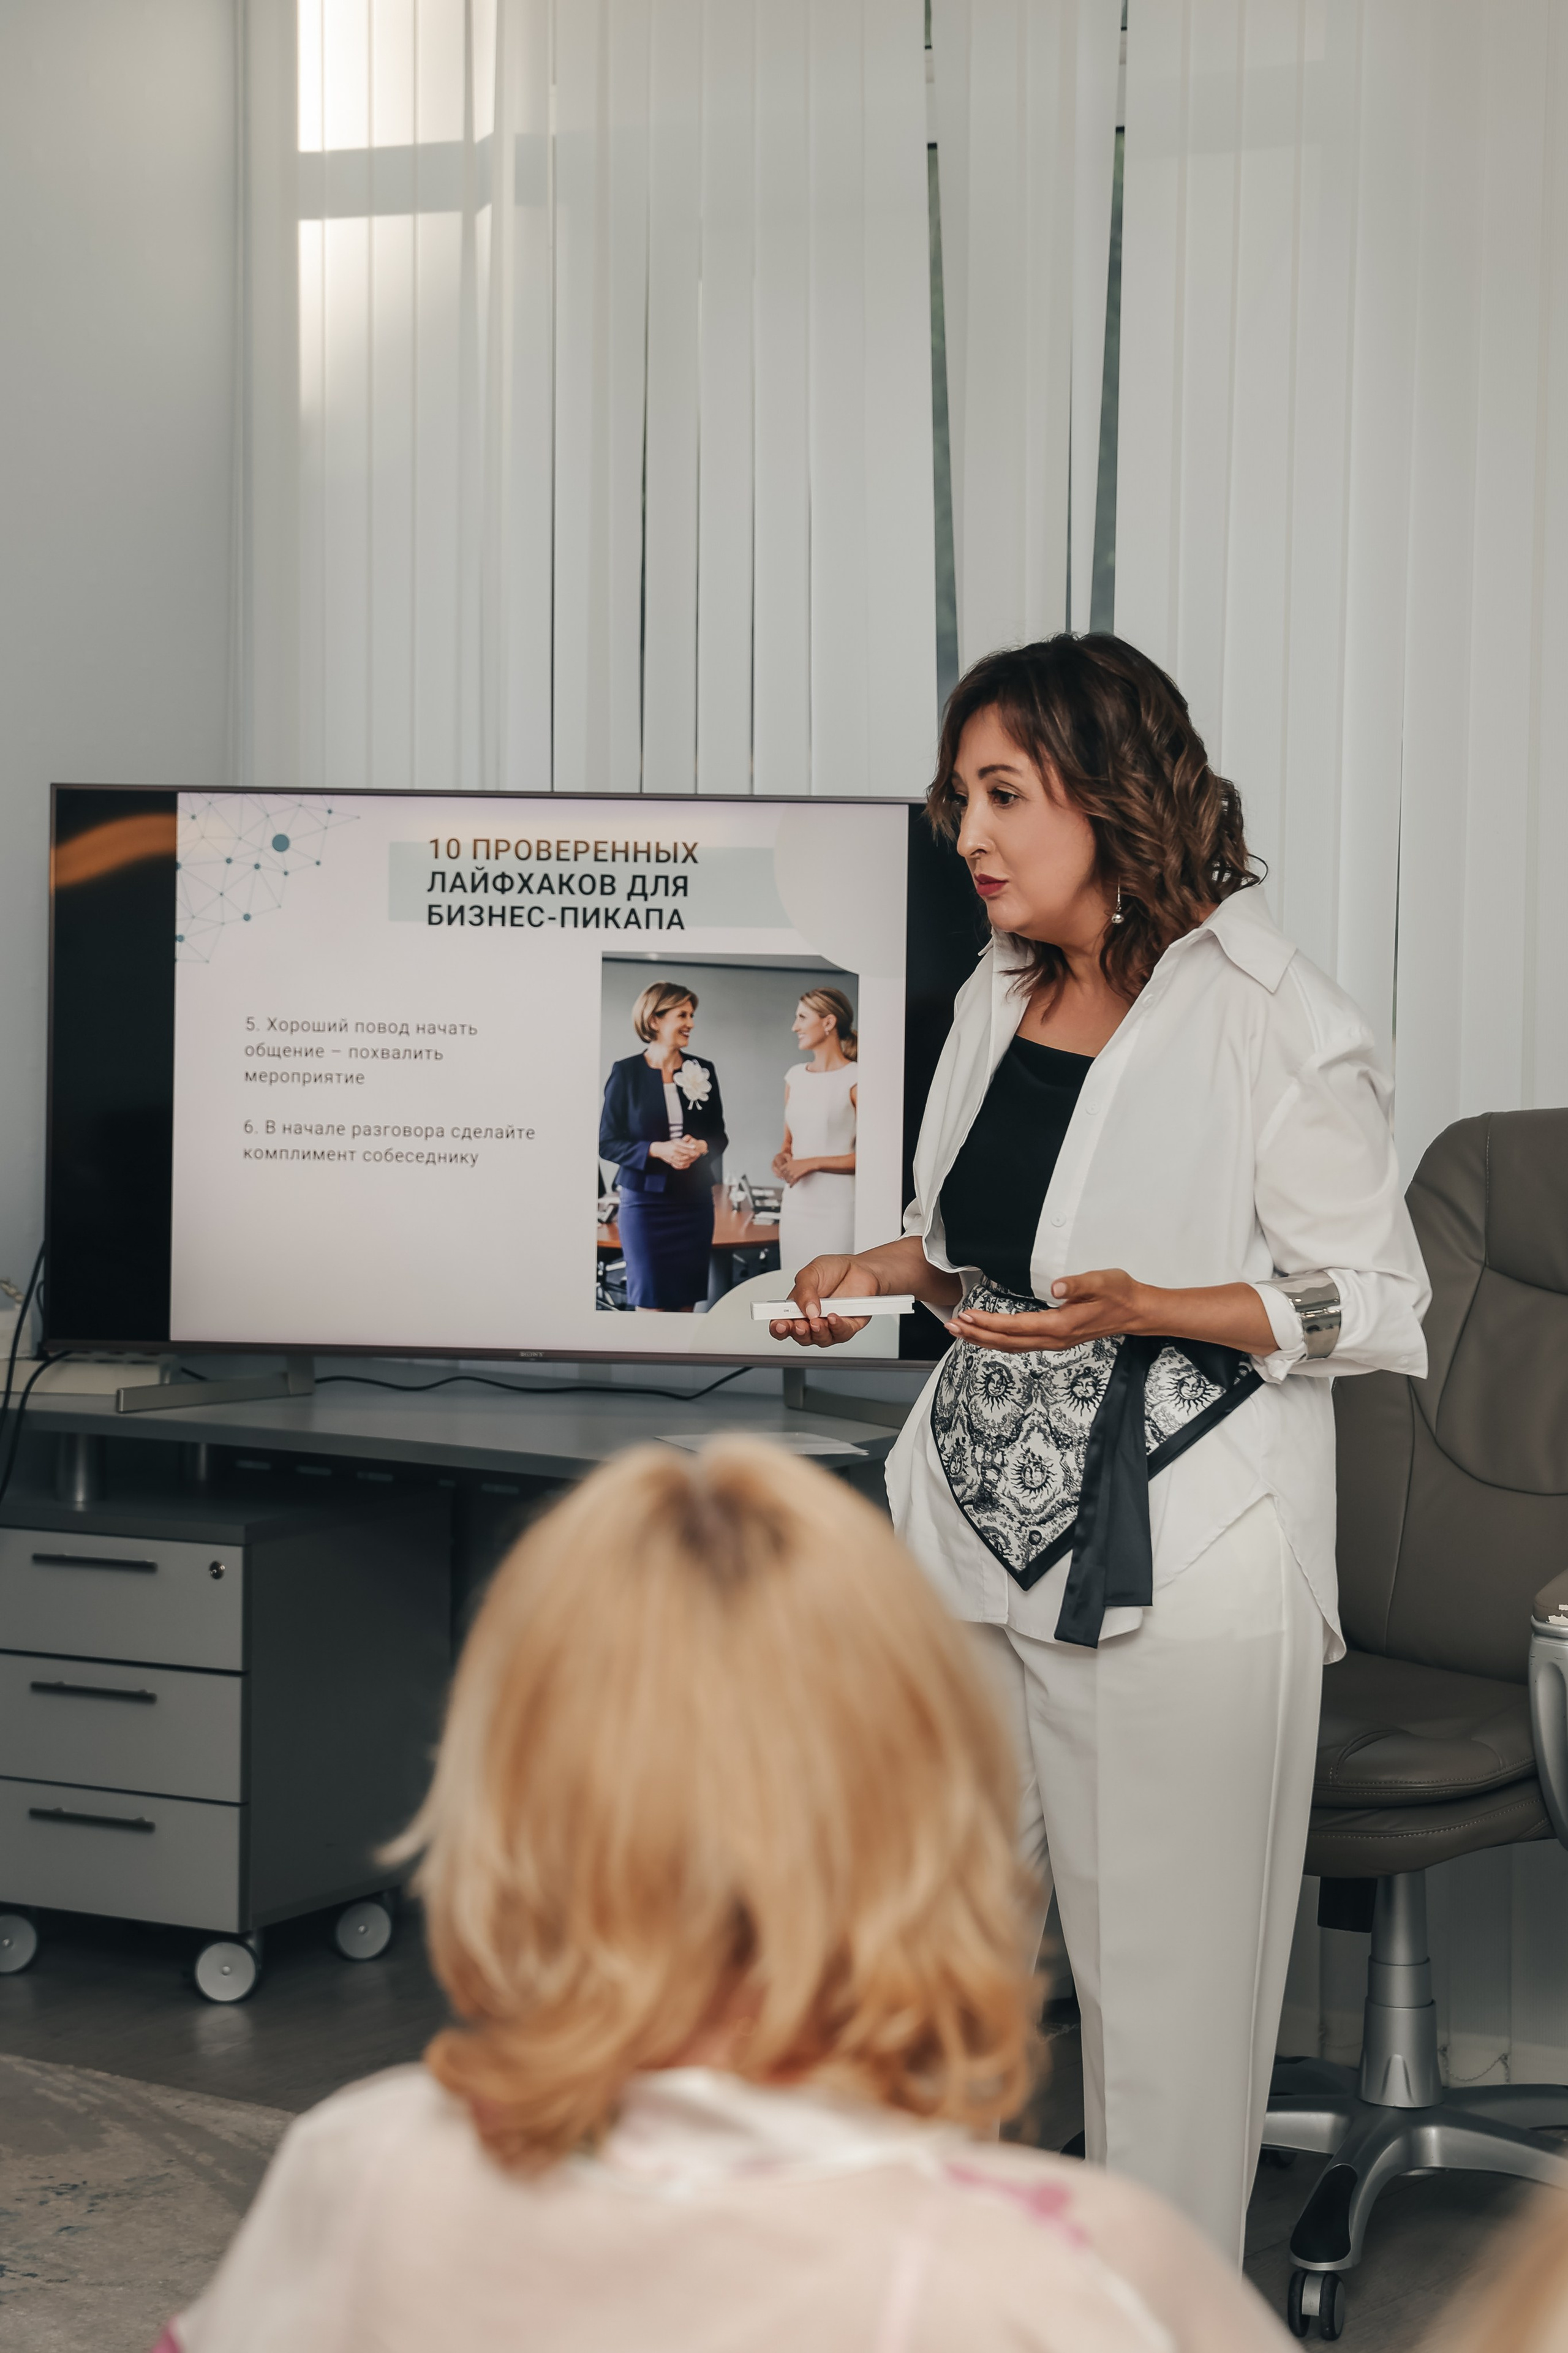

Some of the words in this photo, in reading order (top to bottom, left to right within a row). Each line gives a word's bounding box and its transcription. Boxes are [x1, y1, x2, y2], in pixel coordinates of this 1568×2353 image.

[429, 838, 461, 860] 10
[472, 839, 699, 864] ПРОВЕРЕННЫХ
[427, 866, 616, 896] ЛАЙФХАКОВ
[627, 874, 688, 901] ДЛЯ
[427, 904, 685, 930] БИЗНЕС-ПИКАПА
[246, 1016, 260, 1032] 5.
[266, 1016, 349, 1035] Хороший
[355, 1021, 410, 1037] повод
[416, 1023, 478, 1036] начать
[244, 1042, 325, 1060] общение
[349, 1047, 443, 1061] похвалить
[244, 1071, 365, 1087] мероприятие
[243, 1119, 258, 1135] 6.
[265, 1119, 276, 1135] В
[282, 1123, 346, 1136] начале
[351, 1124, 445, 1141] разговора
[450, 1125, 535, 1141] сделайте
[243, 1147, 356, 1161] комплимент
[362, 1147, 479, 1168] собеседнику
